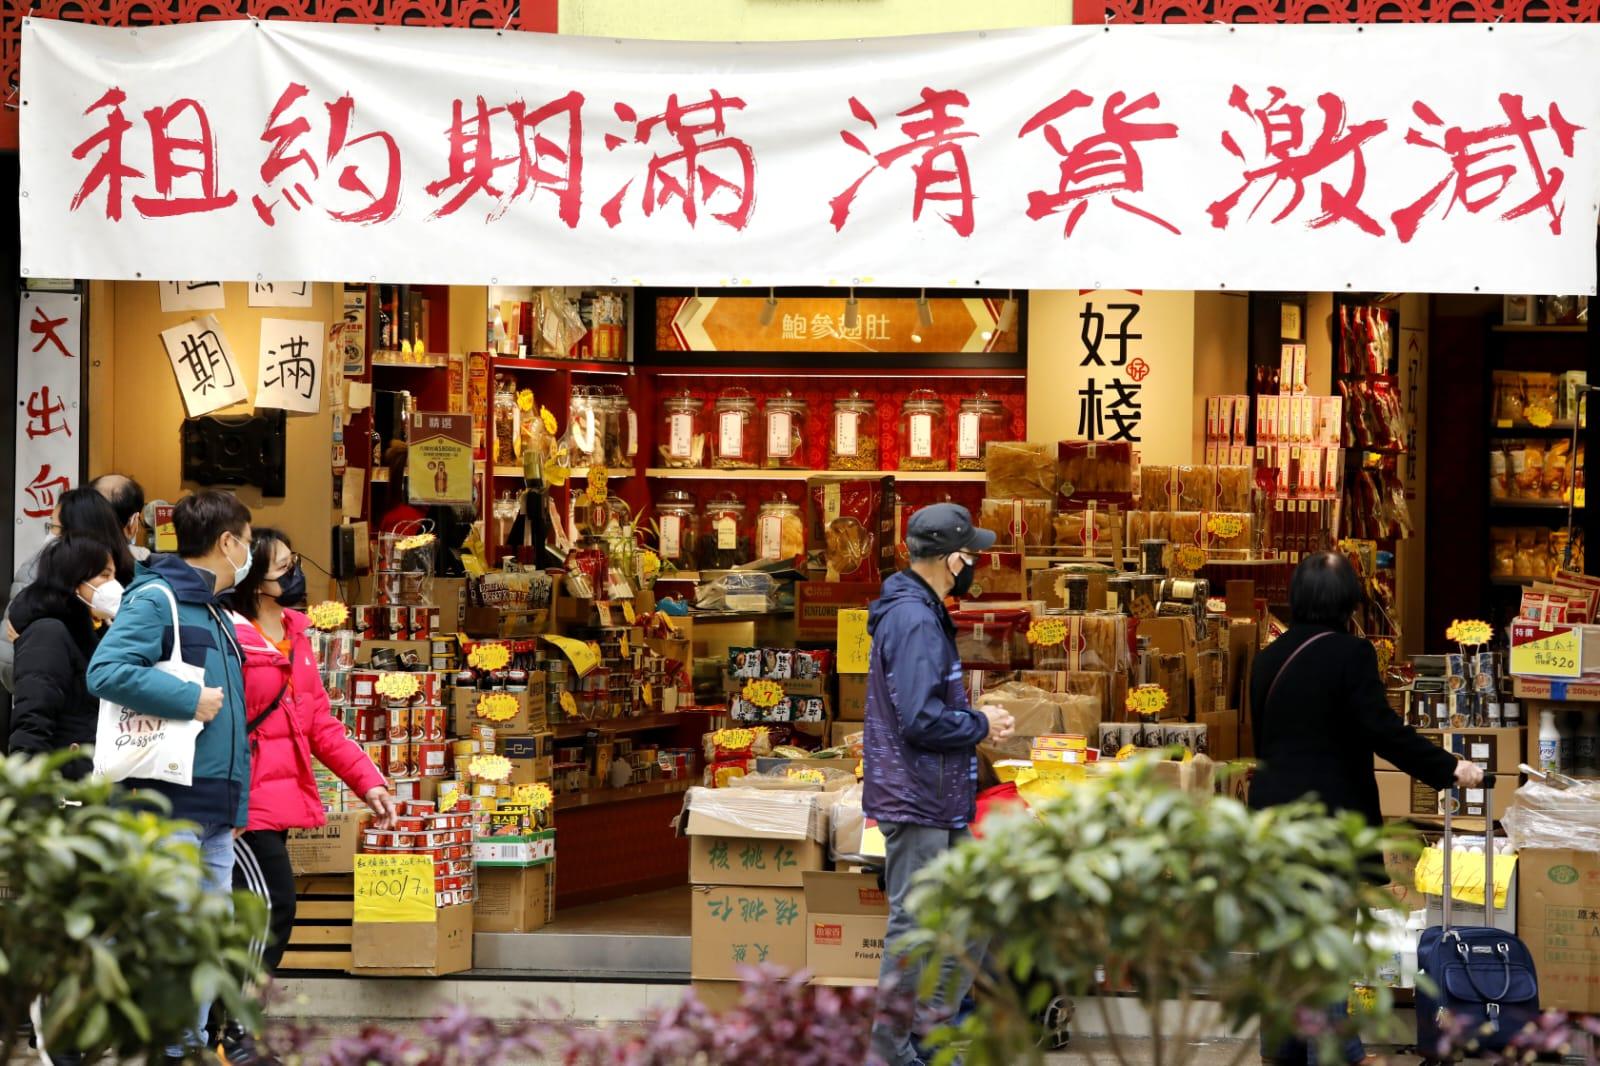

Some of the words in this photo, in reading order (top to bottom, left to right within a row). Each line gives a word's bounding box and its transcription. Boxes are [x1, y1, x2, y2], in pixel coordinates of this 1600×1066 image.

[70, 81, 757, 231] 租約期滿
[829, 83, 1586, 244] 清貨激減
[178, 329, 236, 396] 期
[263, 335, 316, 400] 滿
[1077, 301, 1143, 443] 好棧
[23, 305, 77, 518] 大出血
[1514, 628, 1534, 638] 特價
[1552, 656, 1575, 669] $20
[116, 719, 168, 733] WINE
[115, 731, 166, 751] Passion
[709, 843, 798, 871] 核桃仁
[706, 894, 799, 927] 核桃仁
[731, 942, 770, 963] 天然
[855, 951, 874, 959] Fried
